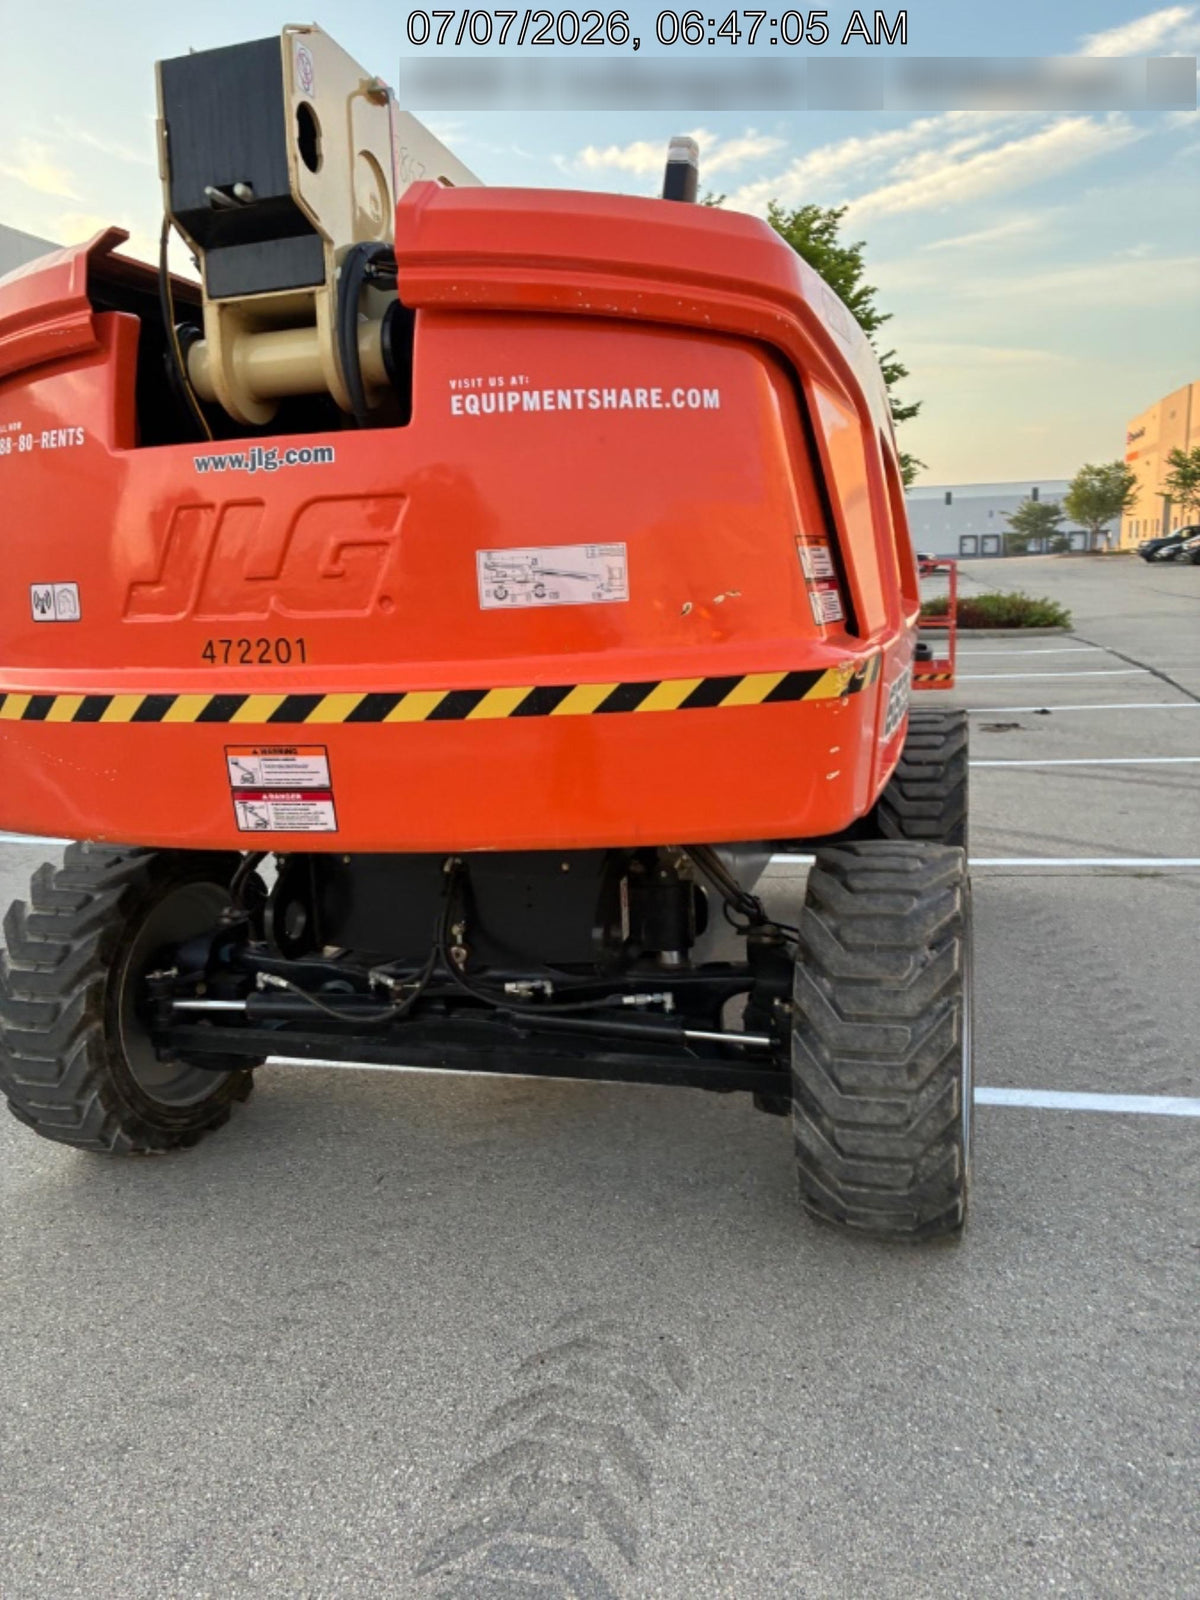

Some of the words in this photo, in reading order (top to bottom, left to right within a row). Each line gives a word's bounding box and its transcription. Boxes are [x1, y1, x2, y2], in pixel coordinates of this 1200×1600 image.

[449, 378, 482, 389] VISIT
[488, 376, 504, 387] US
[510, 375, 529, 386] AT:
[451, 388, 720, 416] EQUIPMENTSHARE.COM
[194, 446, 334, 472] www.jlg.com
[122, 493, 410, 623] JLG
[201, 638, 307, 664] 472201
